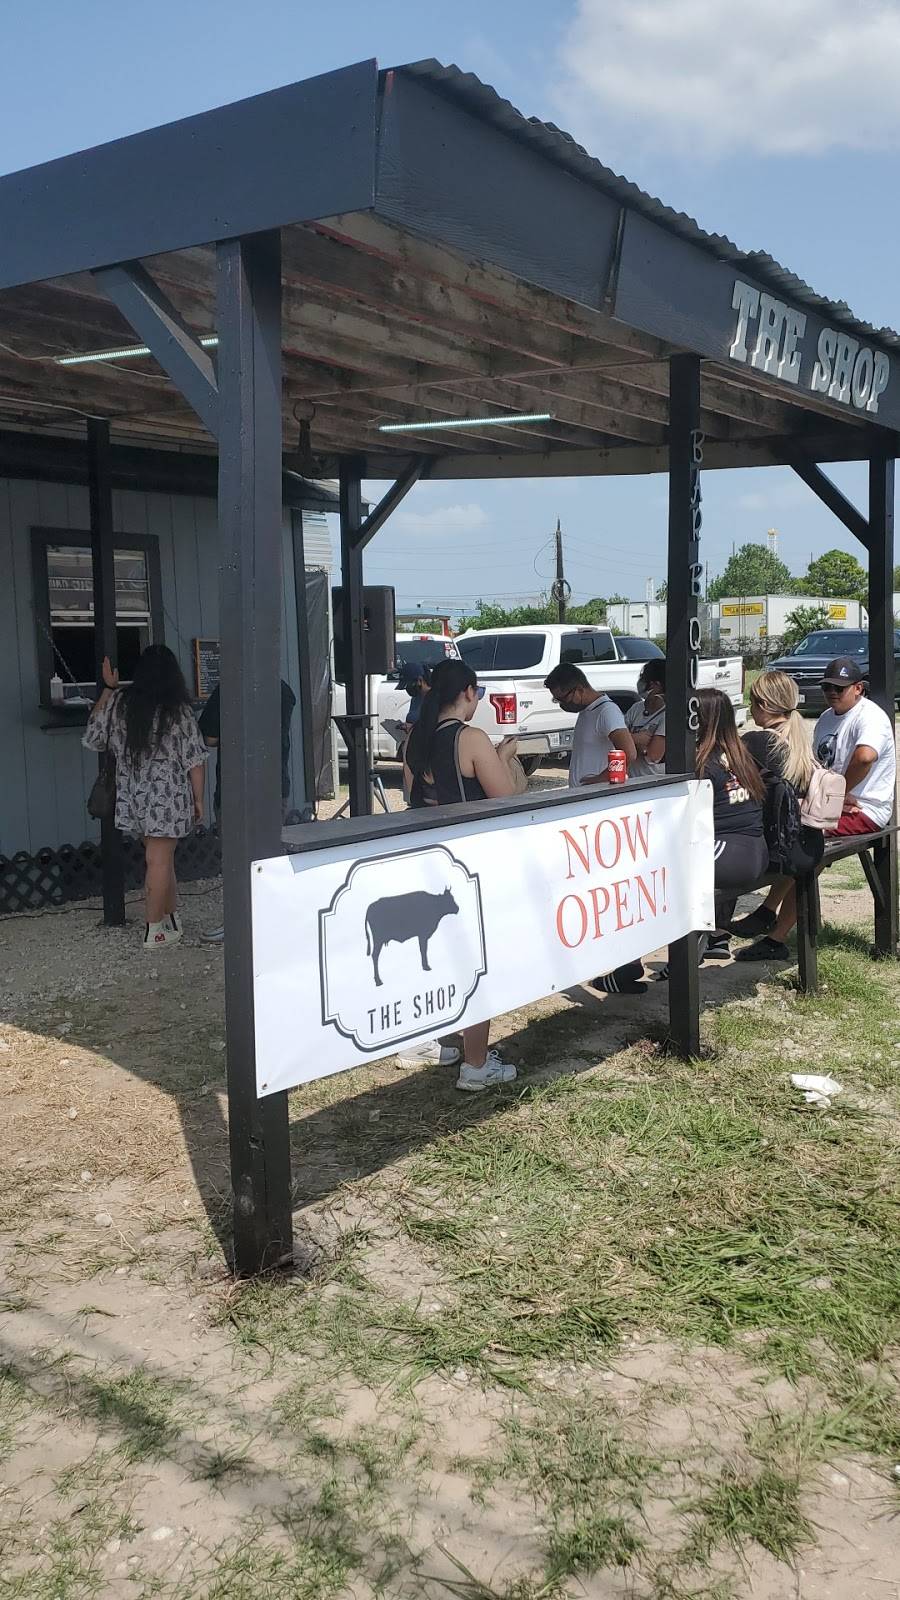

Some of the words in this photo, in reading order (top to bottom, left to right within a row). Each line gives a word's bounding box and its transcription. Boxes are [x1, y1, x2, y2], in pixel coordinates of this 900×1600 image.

[729, 279, 807, 384] THE
[810, 327, 890, 413] SHOP
[688, 562, 704, 597] B
[558, 810, 652, 880] NOW
[556, 866, 668, 949] OPEN!
[366, 998, 402, 1035] THE
[412, 983, 457, 1019] SHOP
